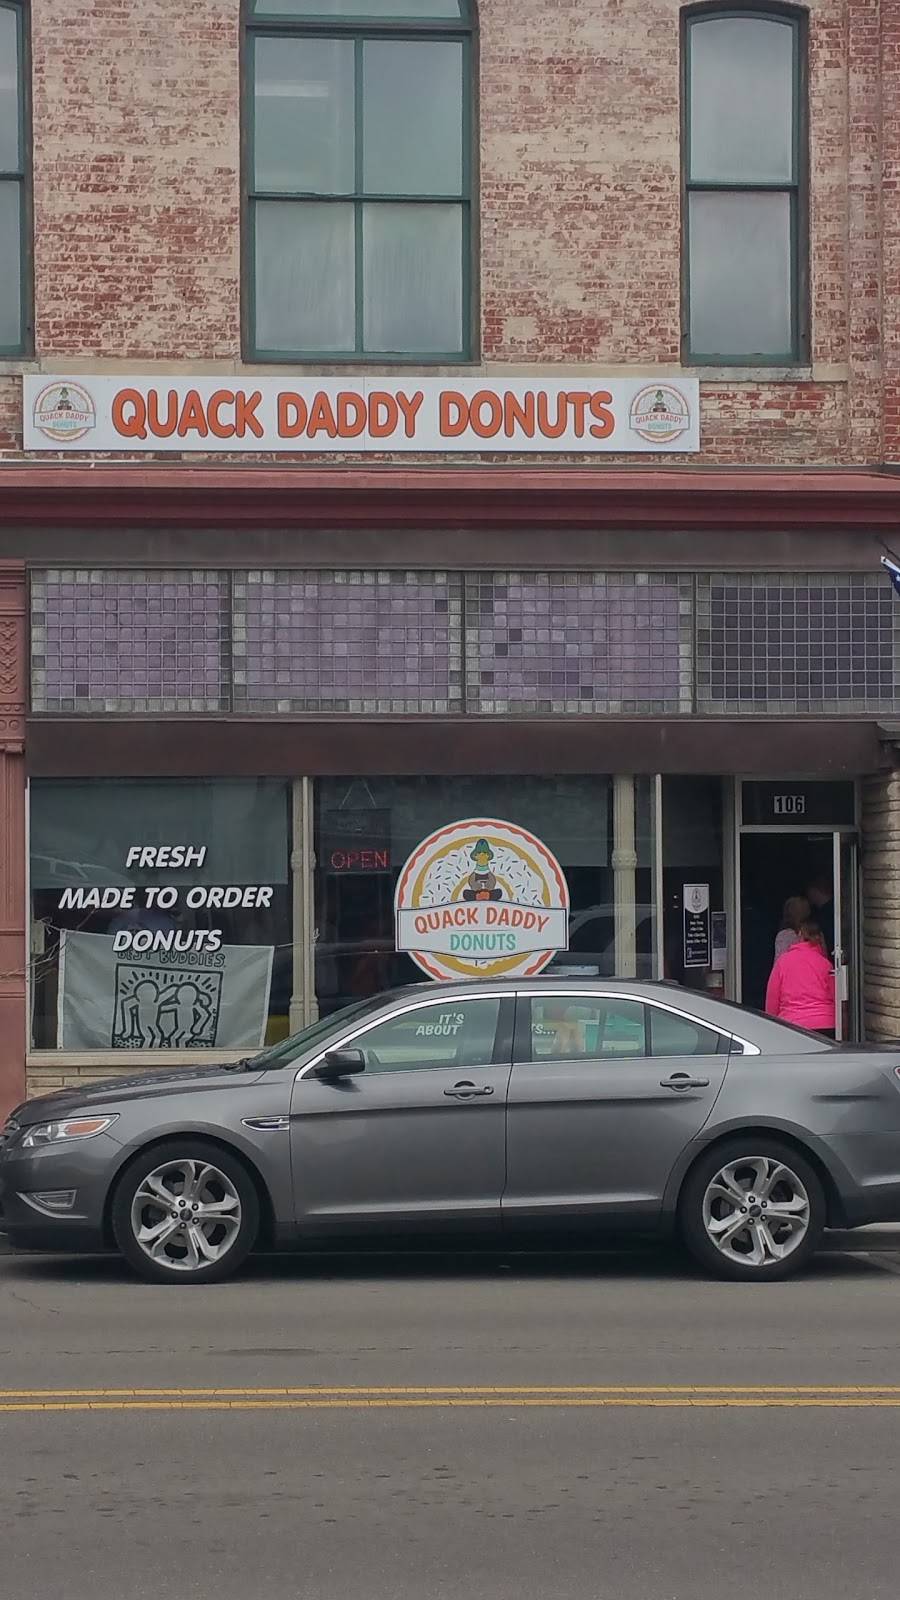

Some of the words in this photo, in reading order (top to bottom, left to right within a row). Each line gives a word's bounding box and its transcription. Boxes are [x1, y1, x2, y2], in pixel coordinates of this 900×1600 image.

[112, 388, 264, 440] QUACK
[277, 391, 424, 438] DADDY
[439, 390, 616, 439] DONUTS
[776, 797, 804, 812] 106
[125, 846, 206, 868] FRESH
[331, 851, 387, 869] OPEN
[58, 886, 136, 909] MADE
[145, 886, 178, 909] TO
[186, 886, 274, 909] ORDER
[414, 907, 479, 934] QUACK
[486, 907, 550, 933] DADDY
[113, 929, 223, 952] DONUTS
[449, 933, 516, 951] DONUTS
[439, 1013, 465, 1025] IT'S
[415, 1025, 460, 1036] ABOUT
